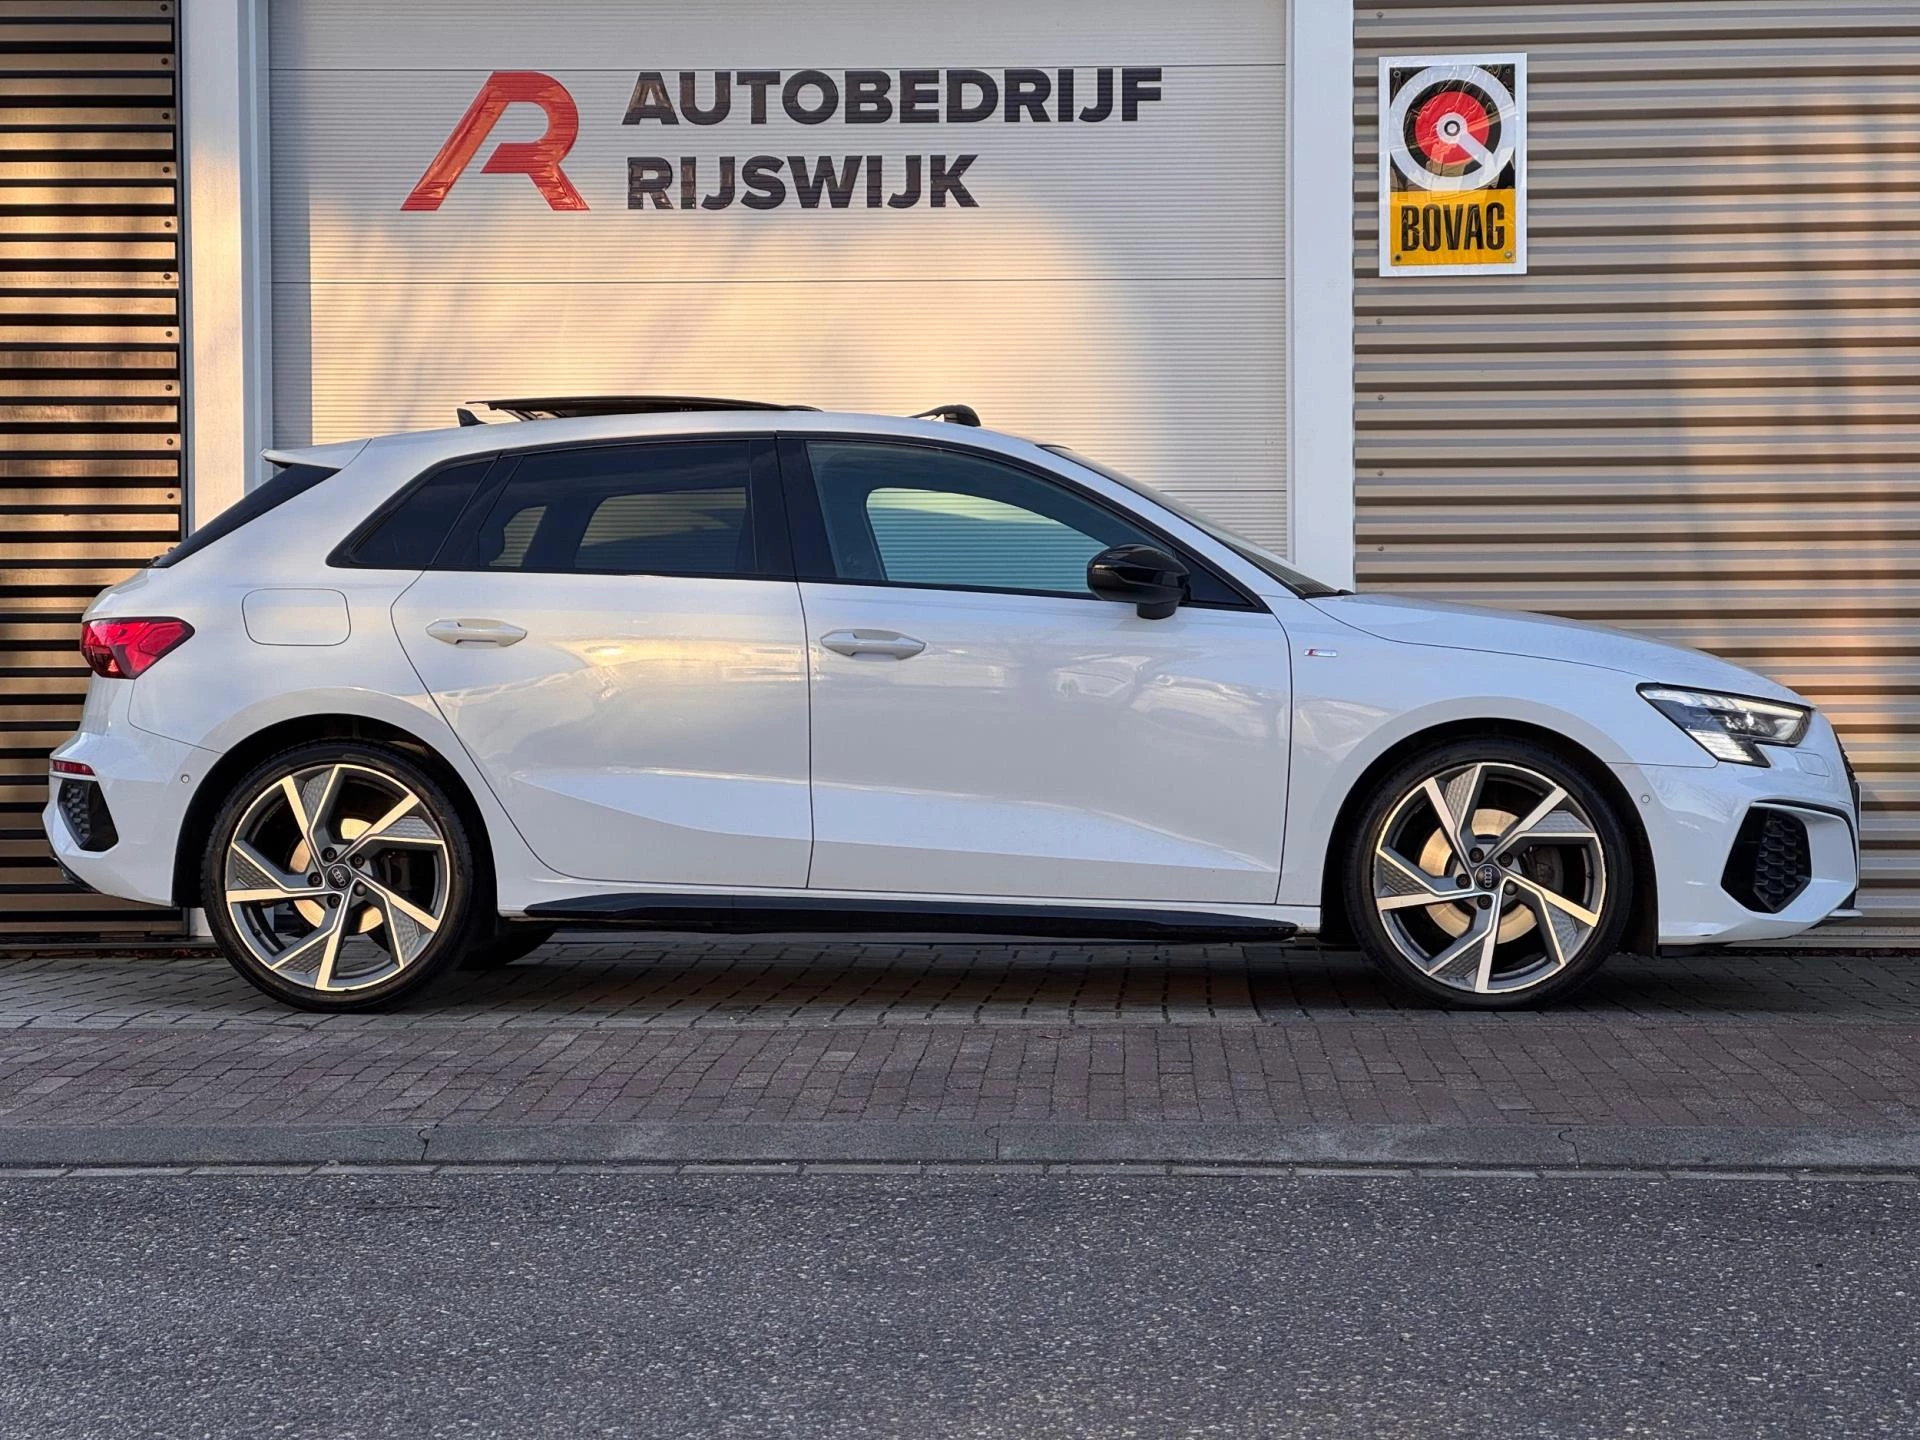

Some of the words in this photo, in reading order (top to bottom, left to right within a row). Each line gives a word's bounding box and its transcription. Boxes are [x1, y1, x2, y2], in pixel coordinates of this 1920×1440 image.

[622, 68, 1162, 125] AUTOBEDRIJF
[627, 154, 980, 210] RIJSWIJK
[1402, 203, 1505, 251] BOVAG
